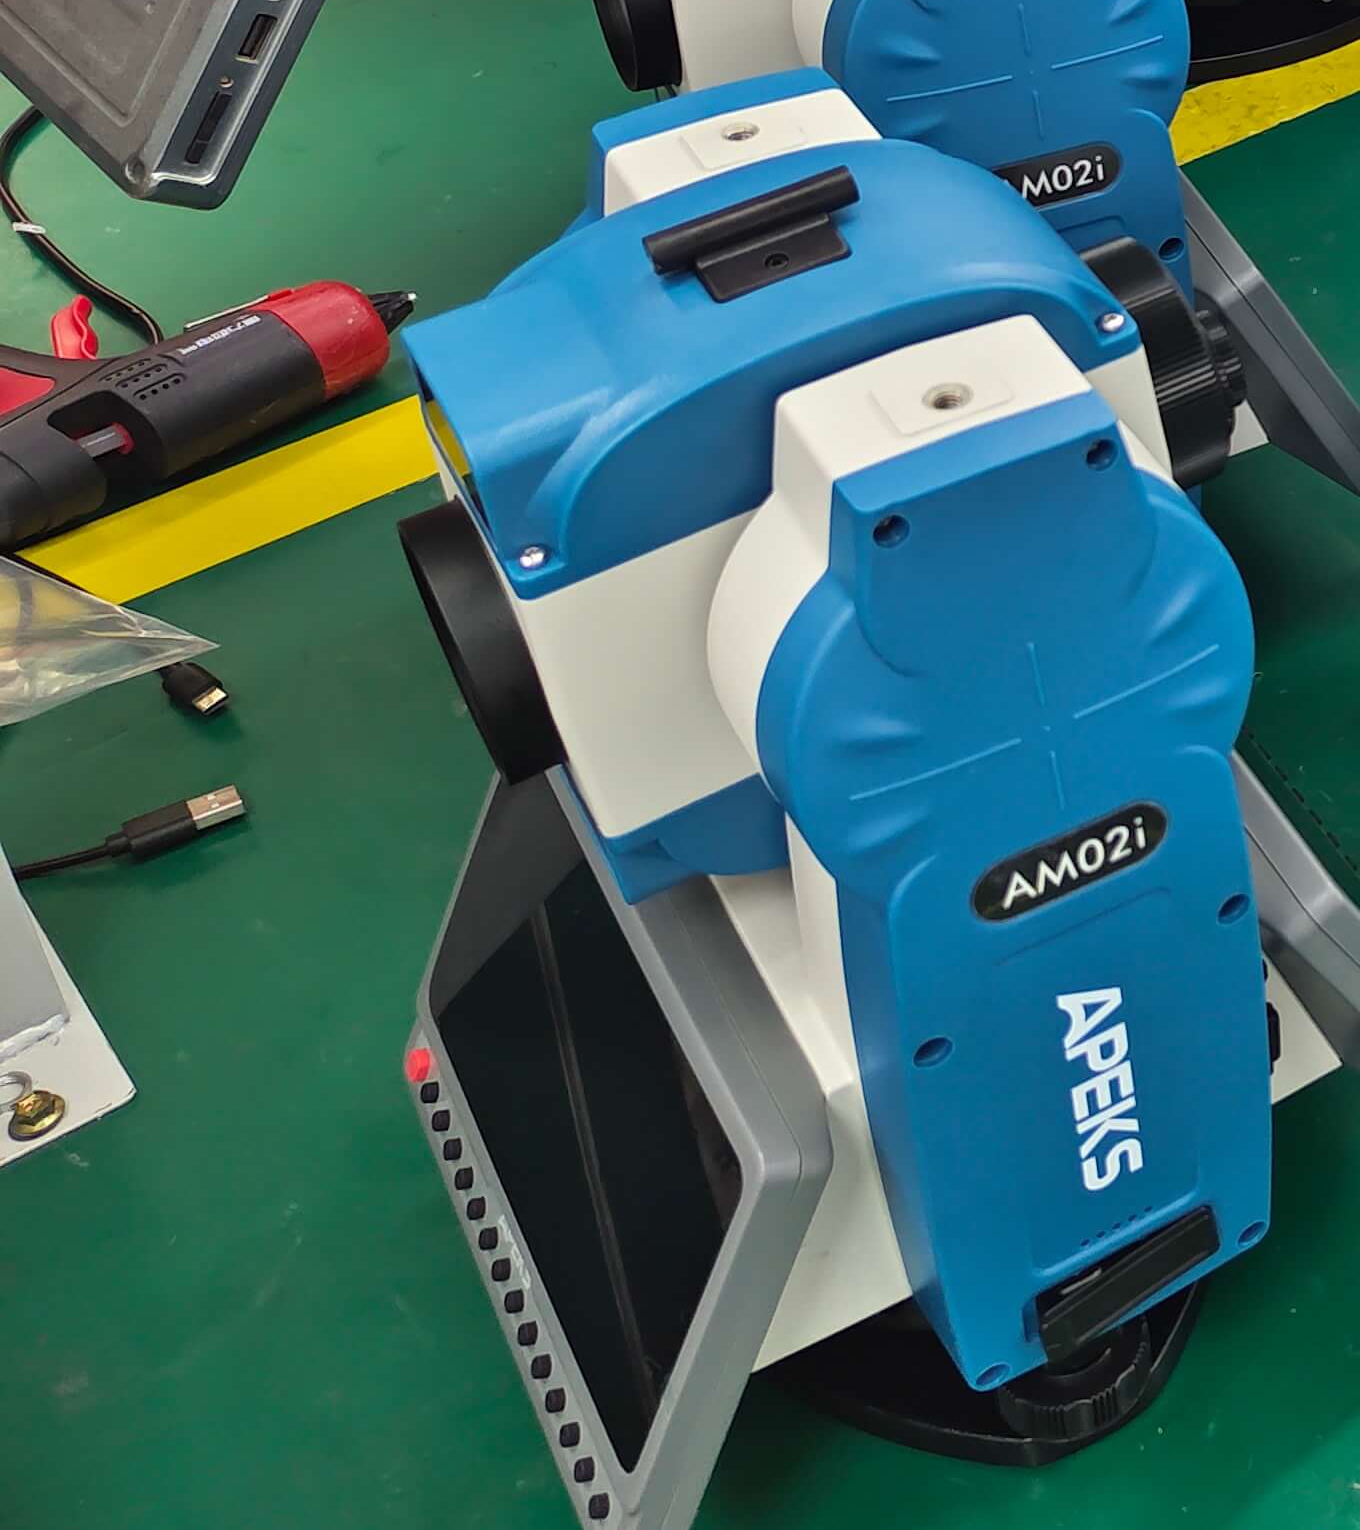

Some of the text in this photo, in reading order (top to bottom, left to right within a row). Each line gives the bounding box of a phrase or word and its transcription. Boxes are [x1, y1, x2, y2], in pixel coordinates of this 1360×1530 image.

[1021, 155, 1106, 200] M02i
[1002, 816, 1147, 911] AM02i
[1056, 986, 1144, 1191] APEKS
